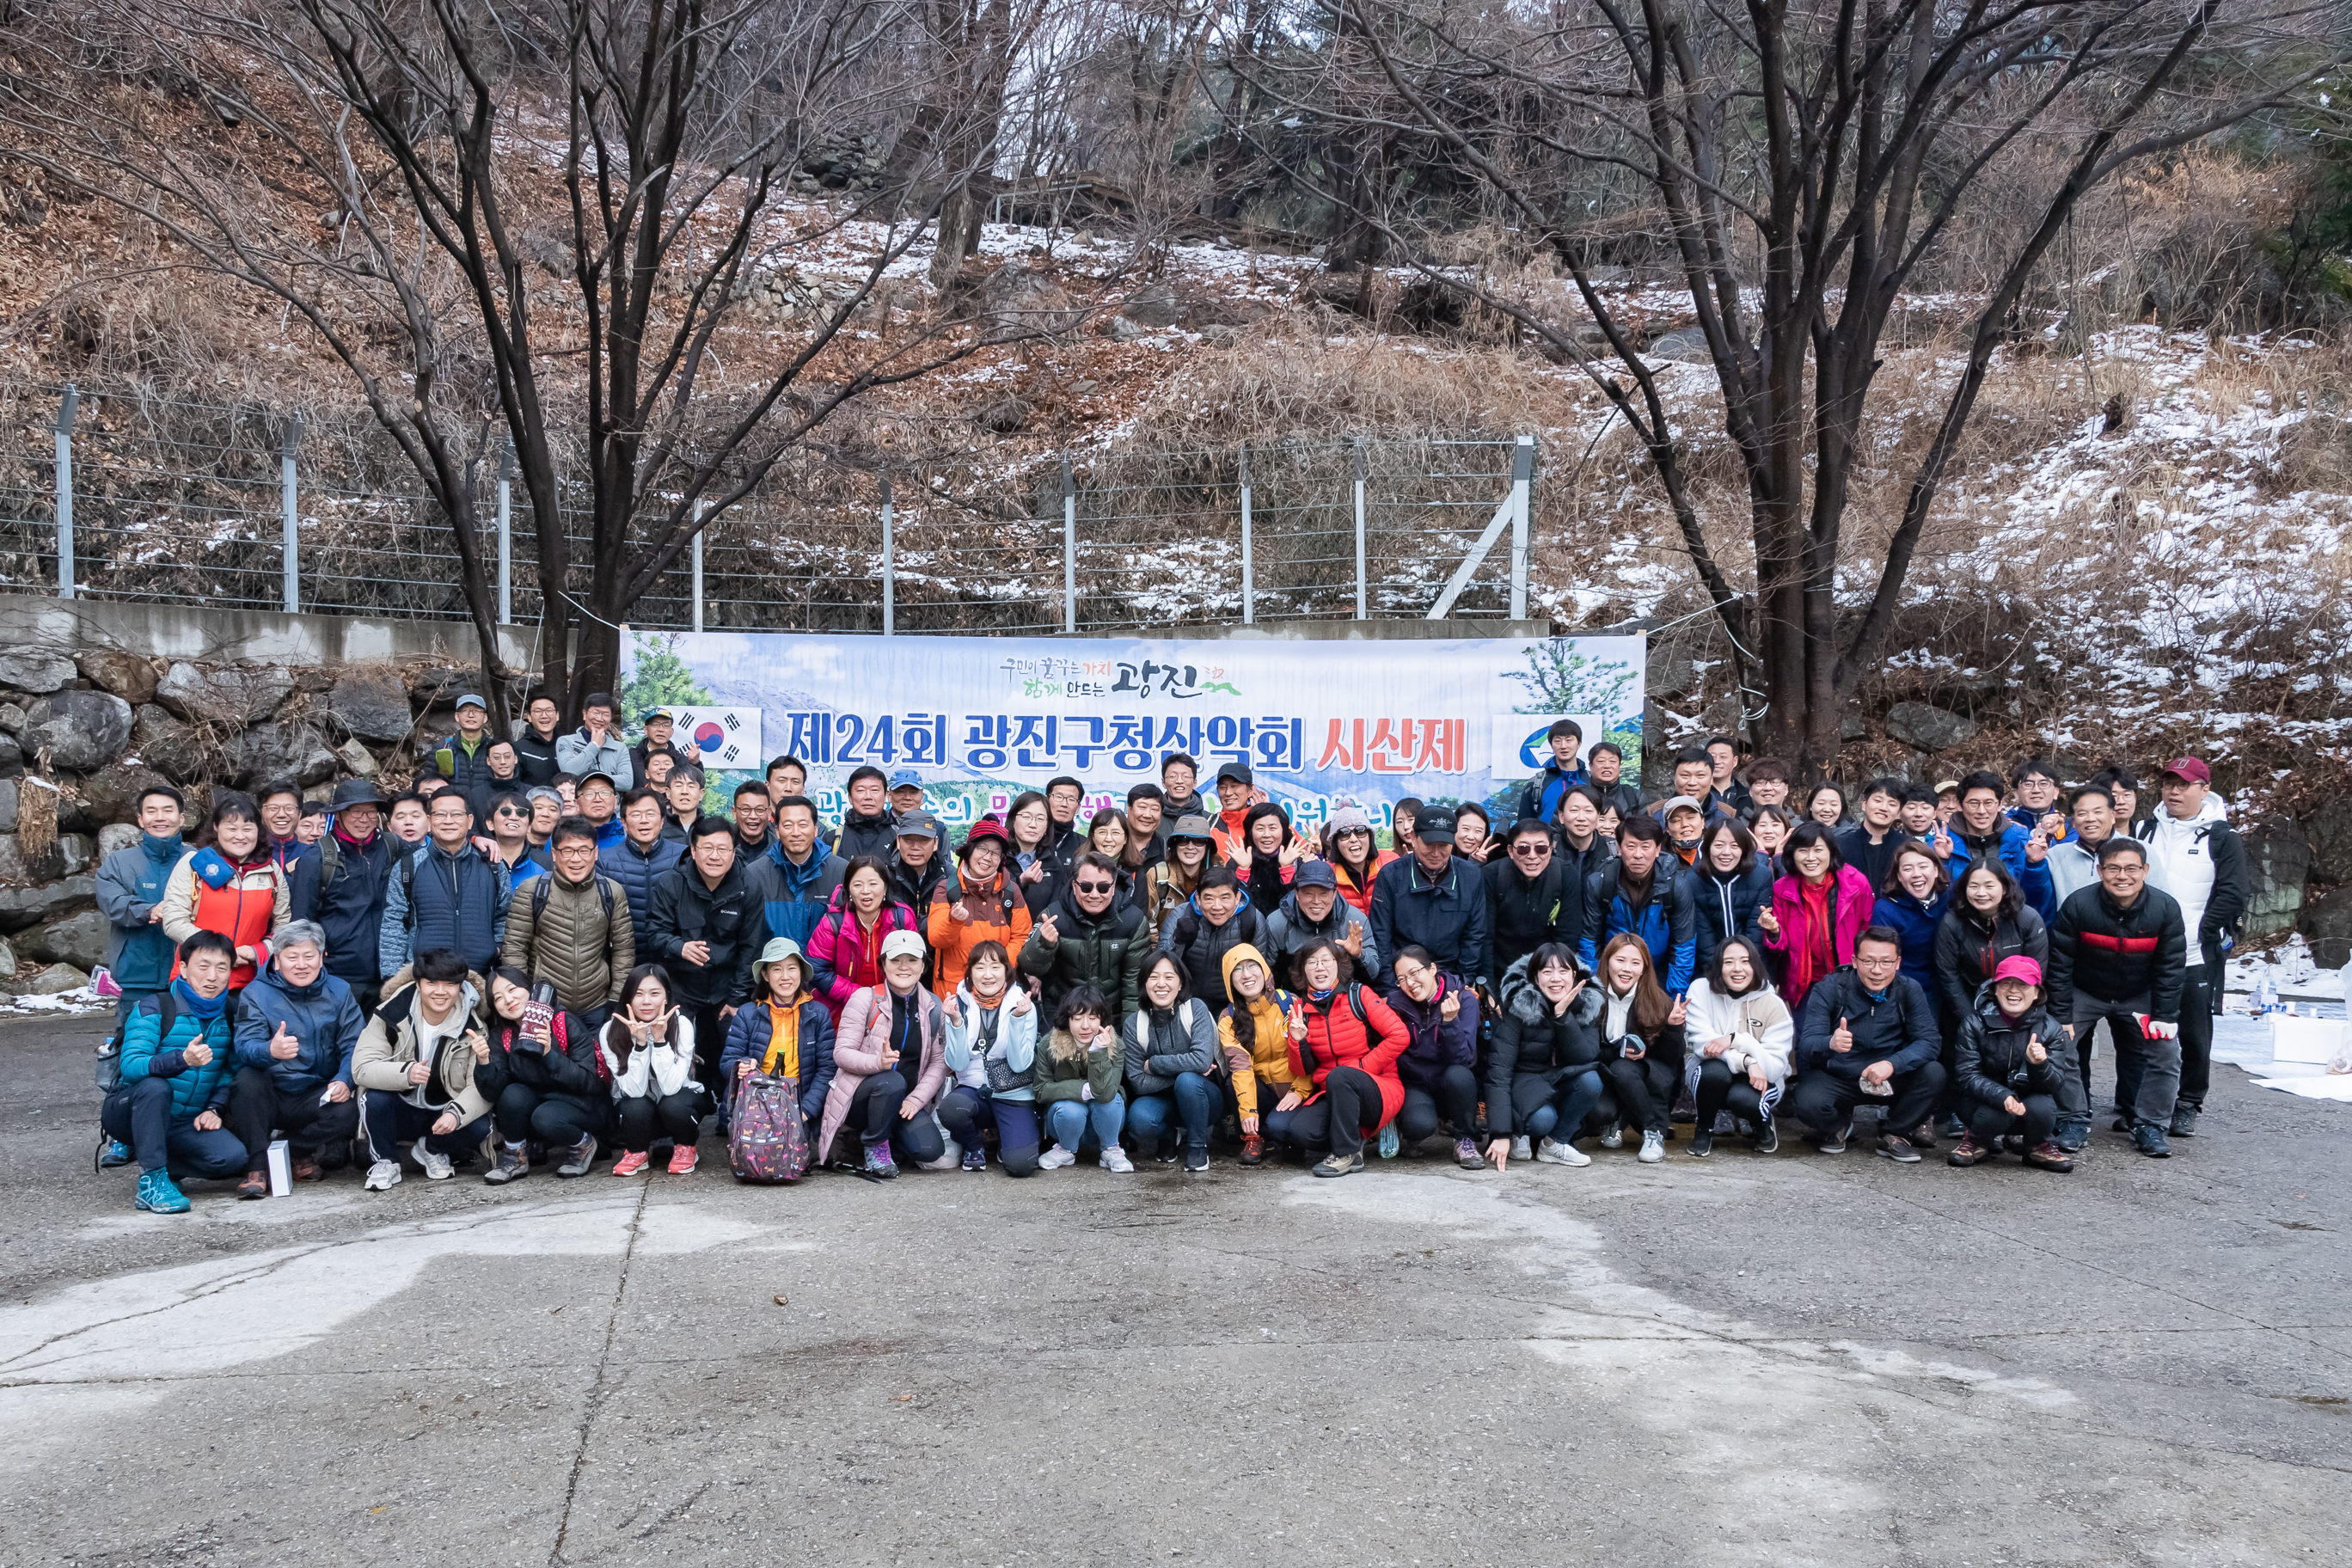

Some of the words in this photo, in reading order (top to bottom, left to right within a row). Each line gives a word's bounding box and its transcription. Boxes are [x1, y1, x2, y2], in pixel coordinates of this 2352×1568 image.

[1000, 658, 1037, 683] 구민이
[1082, 660, 1111, 677] 가치
[1023, 677, 1063, 698] 함께
[1067, 681, 1106, 698] 만드는
[1112, 659, 1203, 699] 광진
[786, 712, 946, 766] 제24회
[963, 715, 1302, 771] 광진구청산악회
[1317, 718, 1465, 772] 시산제
